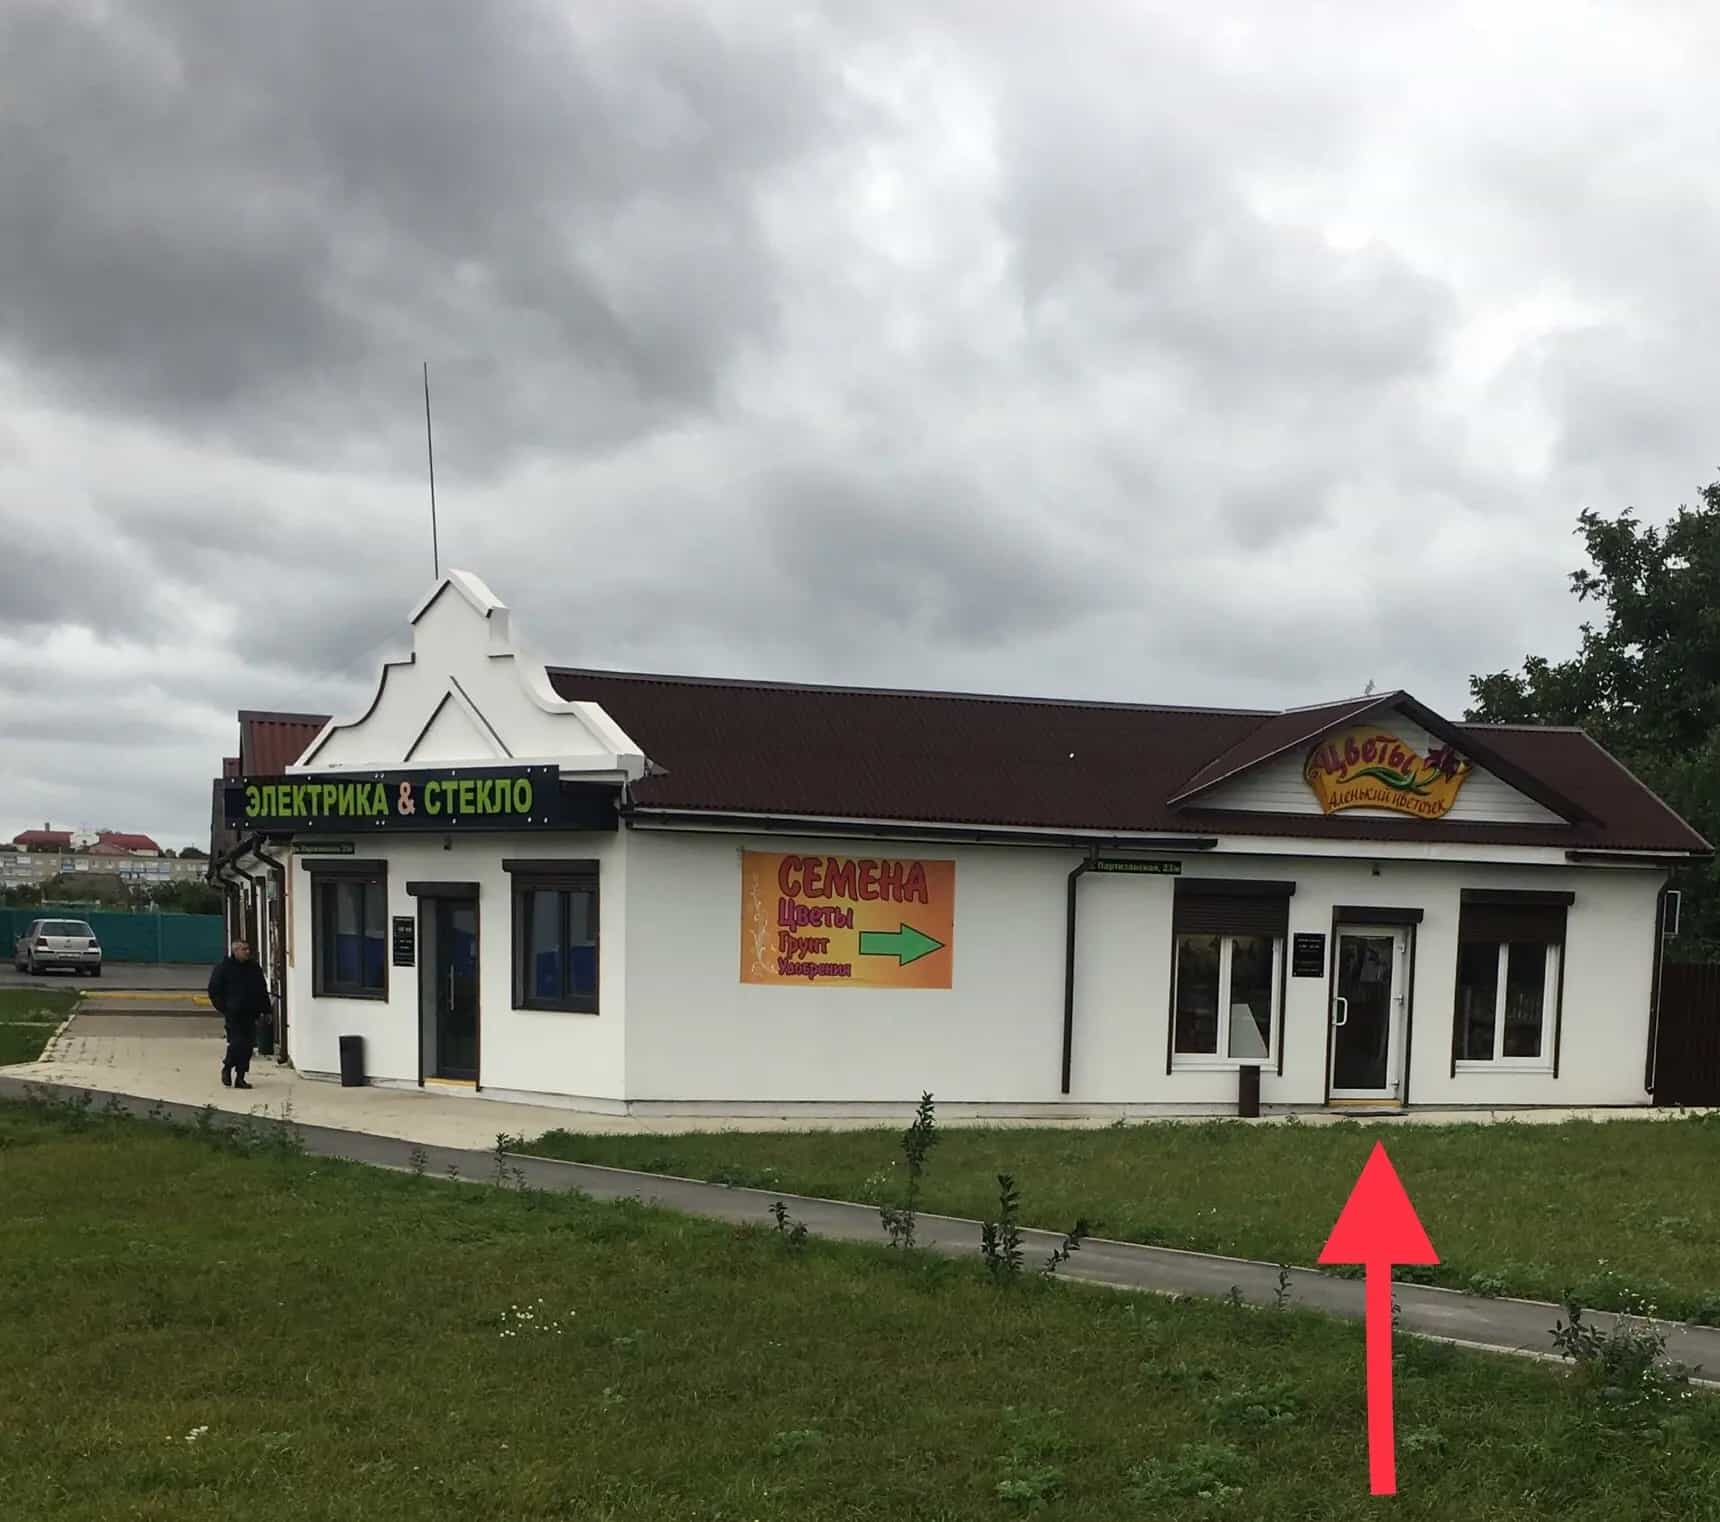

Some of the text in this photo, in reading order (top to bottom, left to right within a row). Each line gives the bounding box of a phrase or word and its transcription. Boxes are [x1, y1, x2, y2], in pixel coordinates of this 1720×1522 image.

[245, 778, 533, 817] ЭЛЕКТРИКА & СТЕКЛО
[778, 855, 928, 904] СЕМЕНА
[777, 897, 854, 933] Цветы
[778, 931, 830, 960] Грунт
[777, 957, 852, 980] Удобрения
